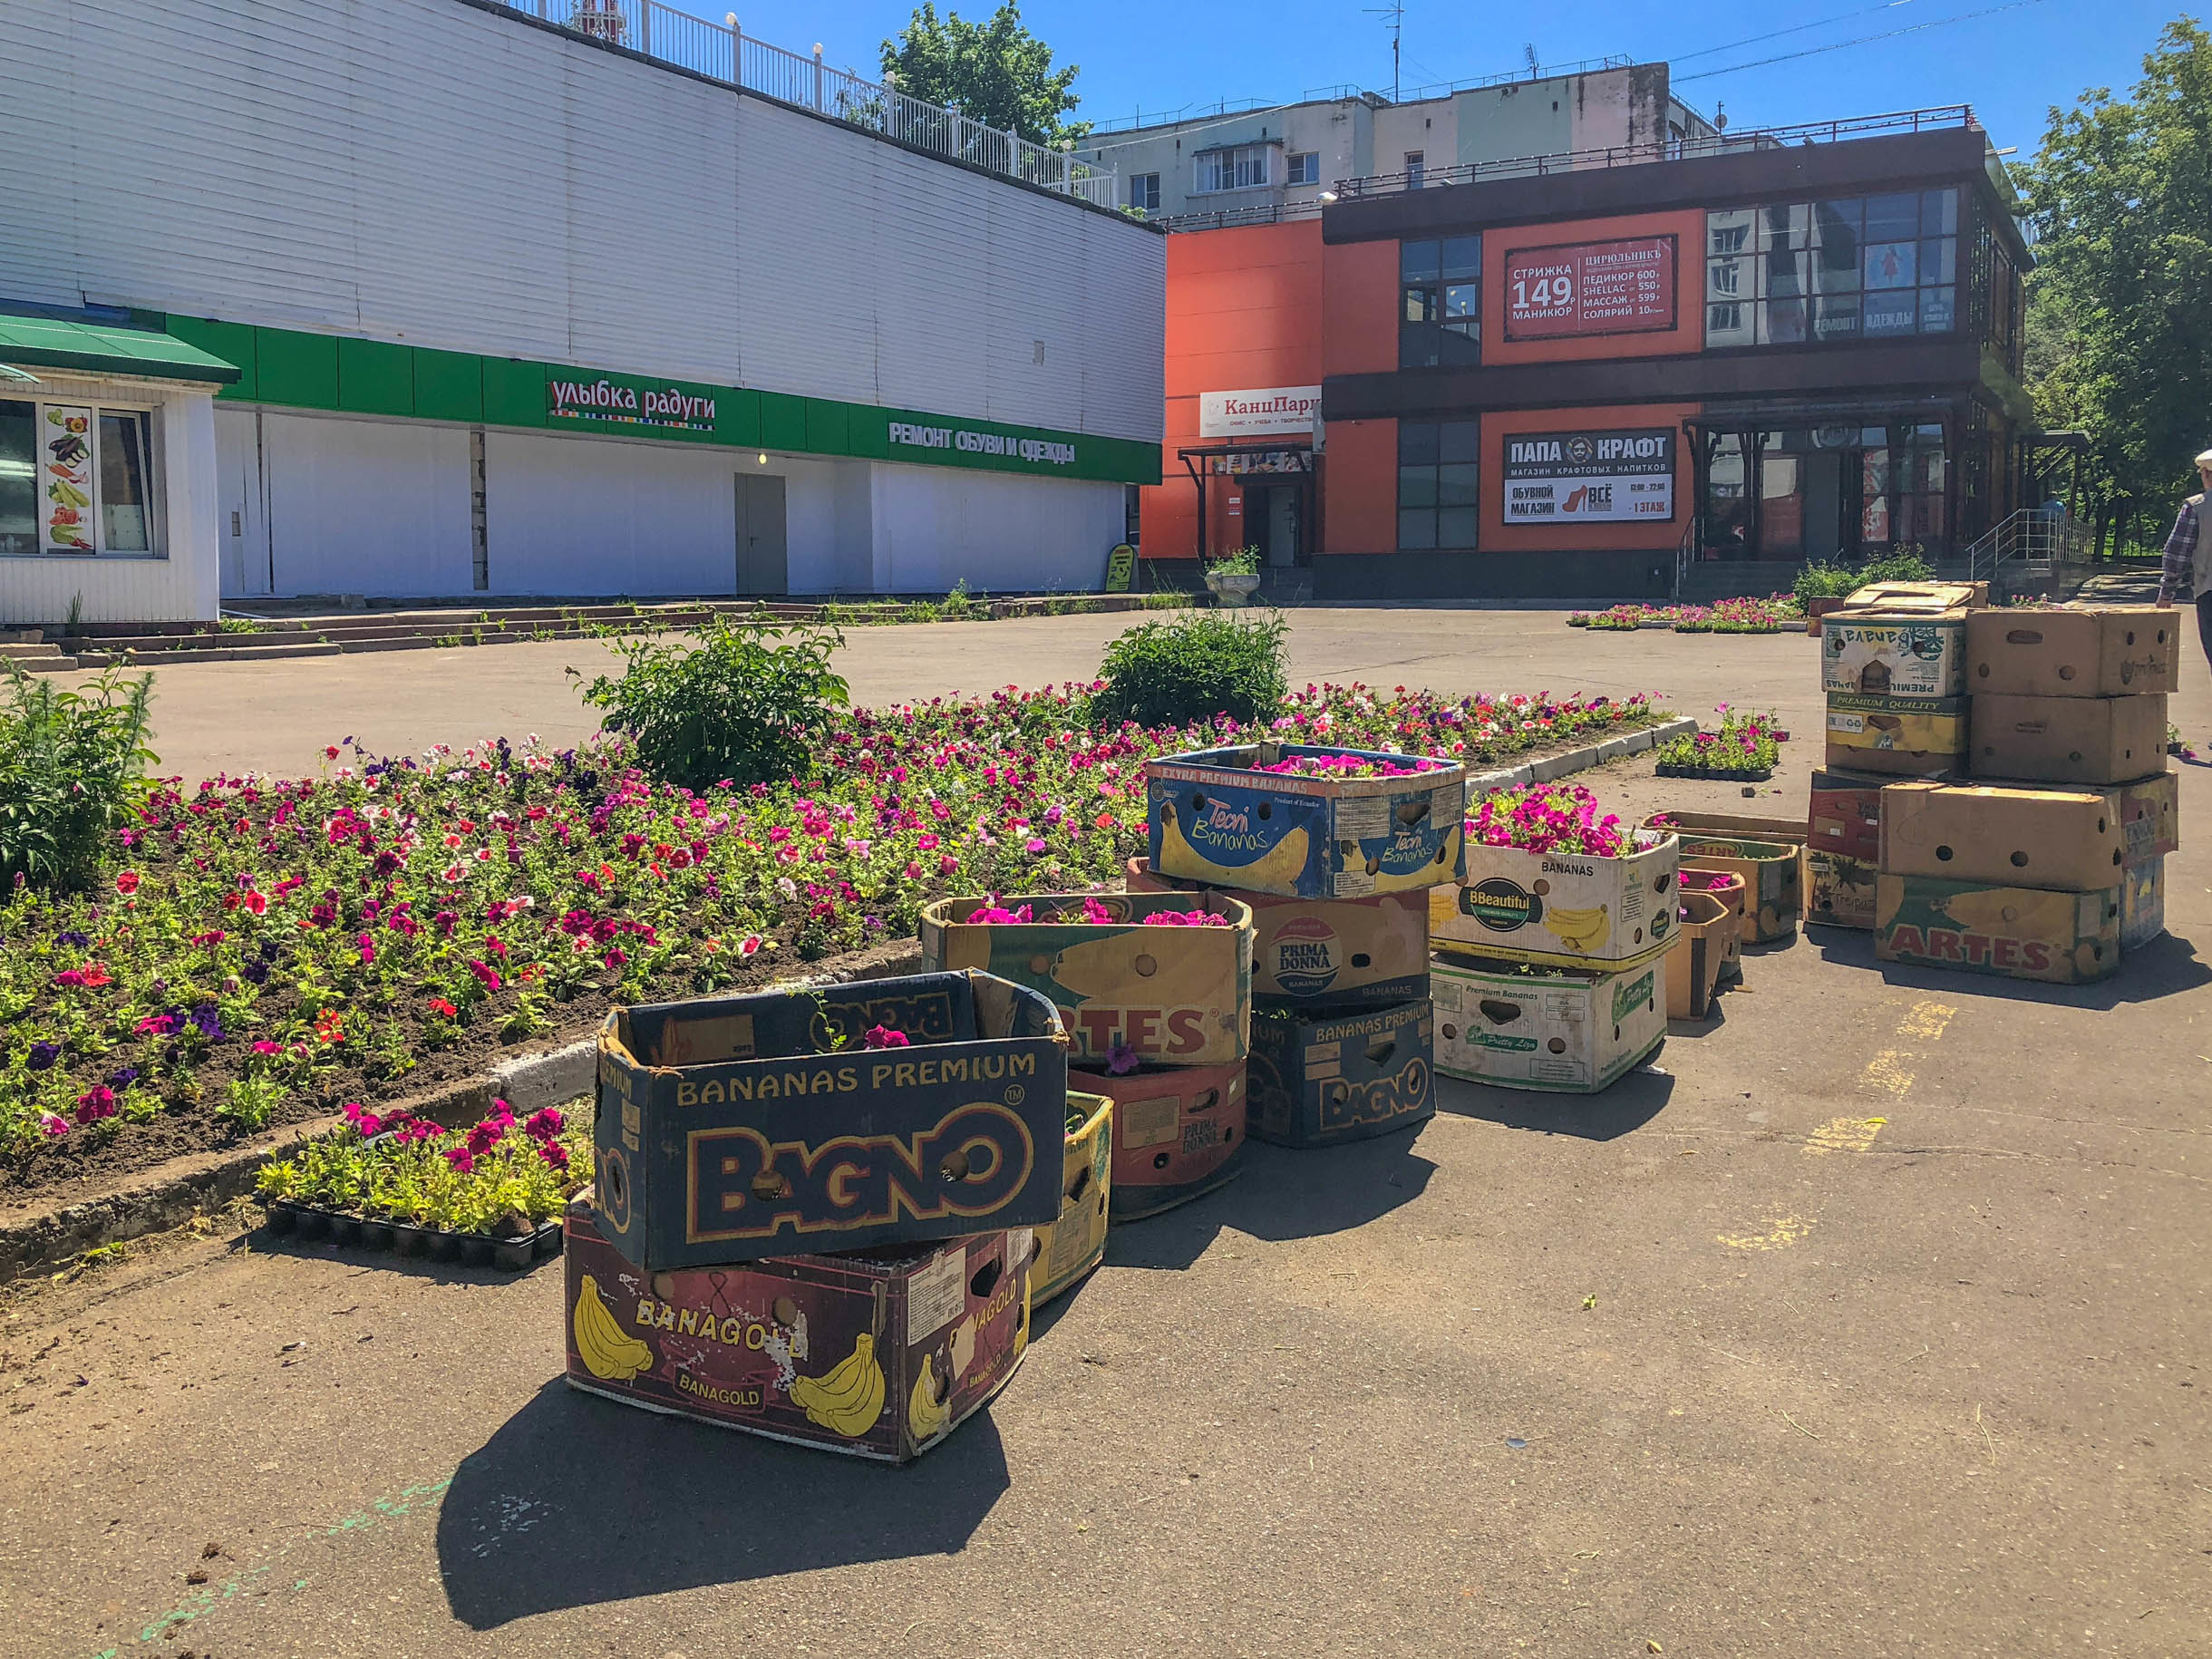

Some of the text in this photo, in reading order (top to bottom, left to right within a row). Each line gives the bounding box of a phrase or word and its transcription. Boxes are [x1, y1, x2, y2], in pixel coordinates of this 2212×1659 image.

[1586, 249, 1661, 266] ЦИРЮЛЬНИКЪ
[1513, 264, 1572, 279] СТРИЖКА
[1583, 272, 1634, 286] ПЕДИКЮР
[1584, 284, 1625, 296] SHELLAC
[1583, 296, 1627, 307] МАССАЖ
[1512, 307, 1572, 320] МАНИКЮР
[1584, 305, 1633, 319] СОЛЯРИЙ
[1866, 312, 1913, 329] ОДЕЖДЫ
[552, 380, 715, 421] улыбка радуги
[888, 422, 1075, 464] РЕМОНТ ОБУВИ И ОДЕЖДЫ
[1510, 436, 1666, 463] ПАПА КРАФТ
[1510, 463, 1666, 476] МАГАЗИН КРАФТОВЫХ НАПИТКОВ
[1512, 484, 1554, 499] ОБУВНОЙ
[1588, 483, 1613, 503] ВСЁ
[1510, 502, 1555, 515] МАГАЗИН
[1640, 500, 1665, 513] ЭТАЖ
[1837, 695, 1939, 710] PREMIUM QUALITY
[1162, 768, 1307, 794] EXTRA PREMIUM BANANAS
[1207, 798, 1249, 833] Tecni
[1191, 817, 1269, 851] Bananas
[1382, 844, 1433, 863] Bananas
[1541, 861, 1594, 877] BANANAS
[1470, 890, 1529, 909] BBeautiful
[1279, 942, 1330, 958] PRIMA
[1888, 923, 2050, 971] ARTES
[1279, 956, 1331, 970] DONNA
[1288, 979, 1324, 988] BANANAS
[1363, 985, 1412, 997] BANANAS
[1465, 985, 1538, 1001] Premium Bananas
[1316, 1017, 1382, 1043] BANANAS
[1384, 1003, 1430, 1031] PREMIUM
[676, 1053, 1035, 1107] BANANAS PREMIUM
[1320, 1057, 1429, 1131] BAGNO
[686, 1101, 1034, 1245] BAGNO
[680, 1374, 760, 1406] BANAGOLD
